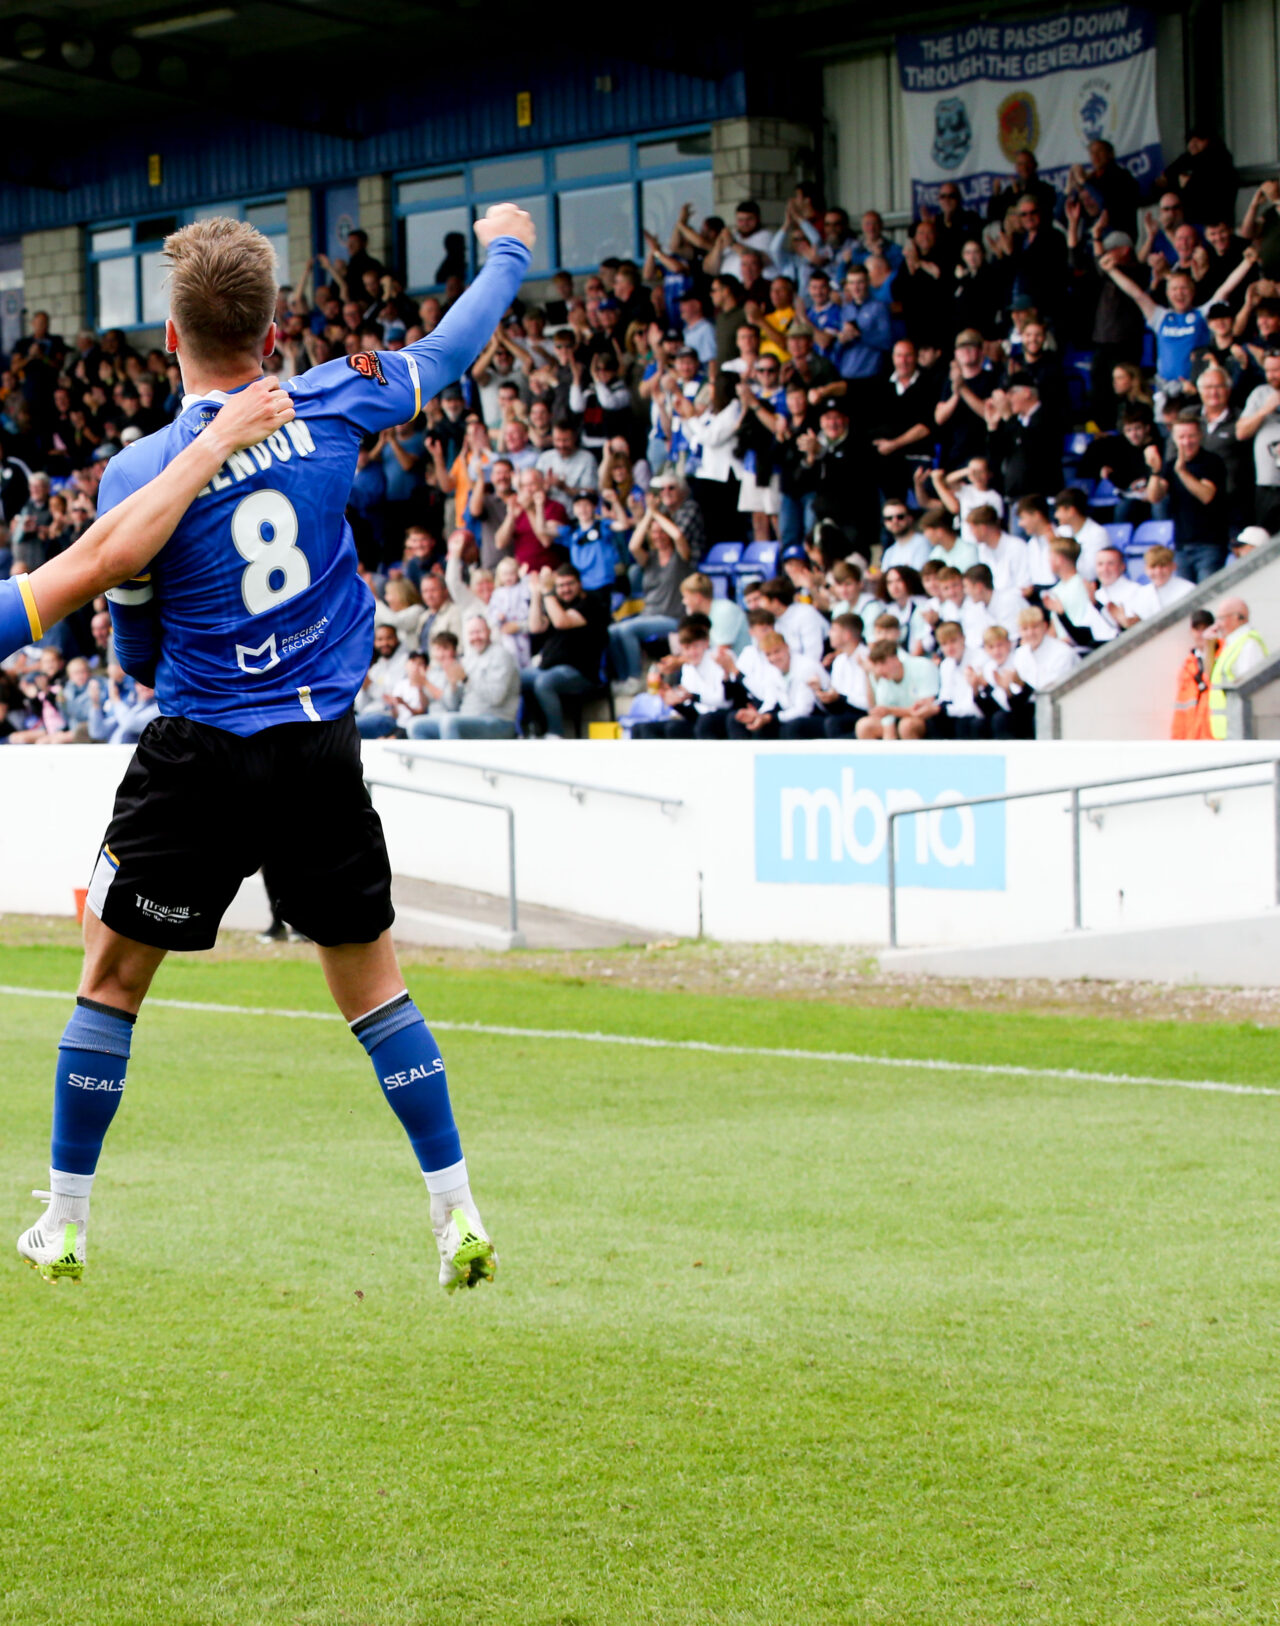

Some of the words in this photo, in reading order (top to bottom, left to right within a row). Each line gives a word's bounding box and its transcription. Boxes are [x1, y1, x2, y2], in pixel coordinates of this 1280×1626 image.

[904, 55, 985, 88] THROUGH
[985, 54, 1021, 77] THE
[1024, 28, 1143, 75] GENERATIONS
[920, 36, 954, 61] THE
[957, 27, 1000, 53] LOVE
[1003, 16, 1070, 49] PASSED
[1073, 7, 1129, 37] DOWN
[198, 419, 317, 498] ENDON
[231, 489, 311, 617] 8
[281, 616, 328, 646] PRECISION
[780, 767, 976, 868] mbna
[67, 1073, 126, 1093] SEALS
[383, 1058, 445, 1091] SEALS
